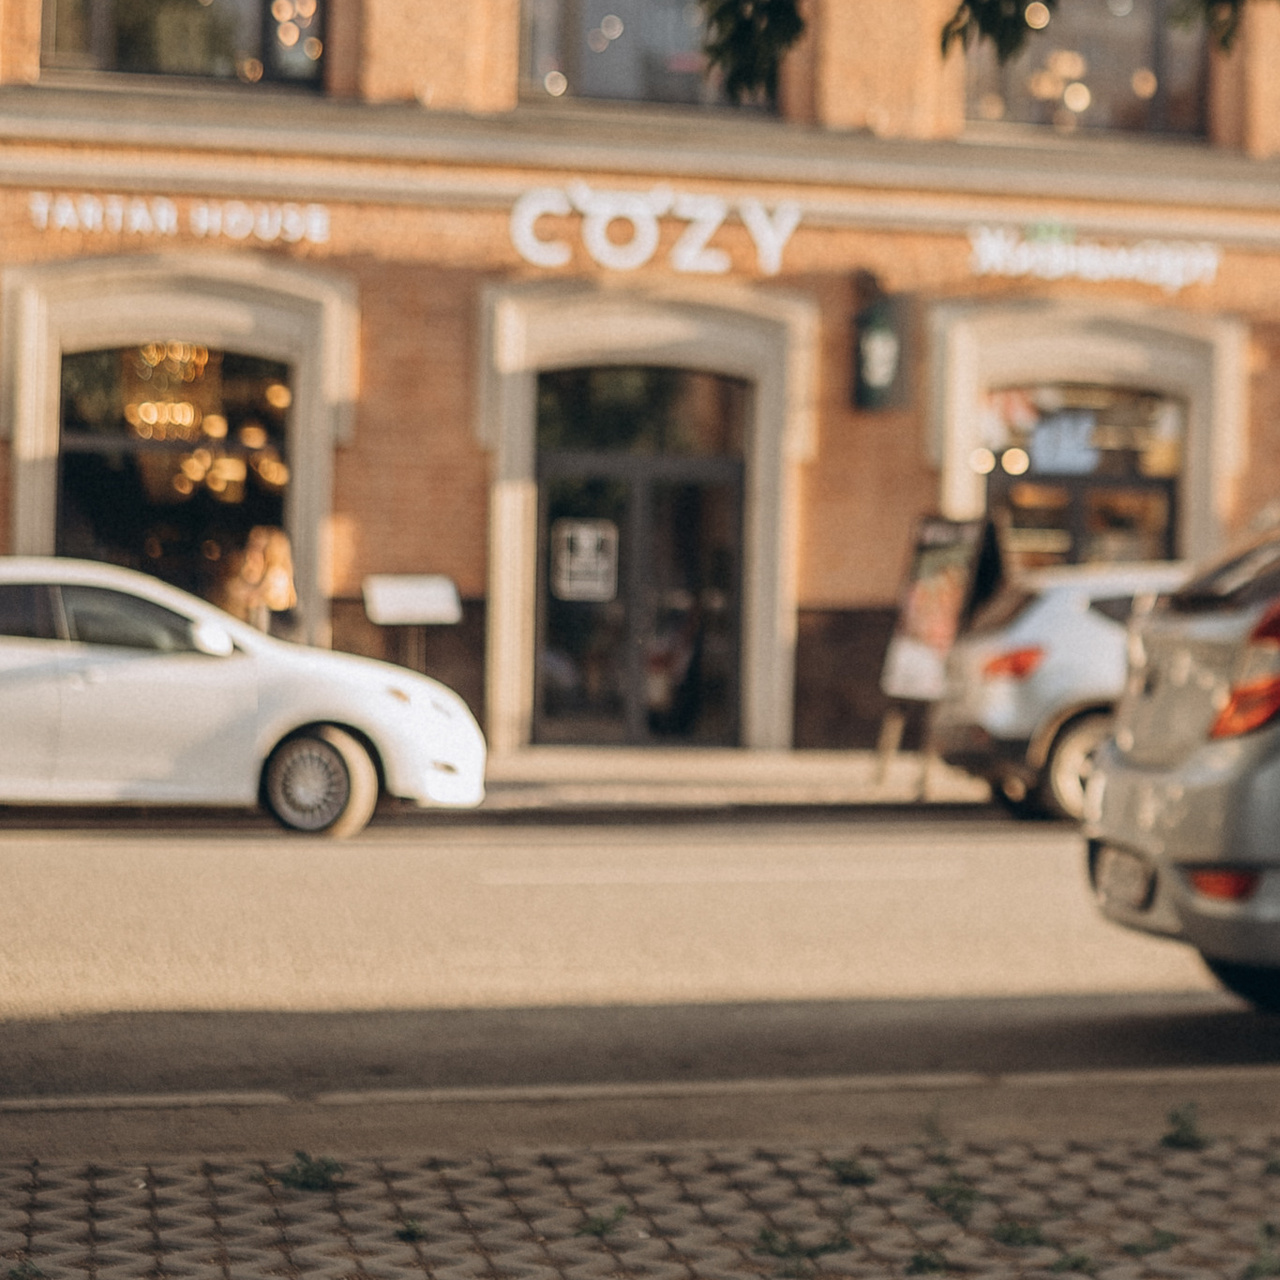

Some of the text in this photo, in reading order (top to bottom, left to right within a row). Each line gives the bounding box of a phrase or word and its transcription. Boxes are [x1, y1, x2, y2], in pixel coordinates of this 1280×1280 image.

[29, 191, 330, 244] TARTAR HOUSE
[509, 180, 801, 275] COZY
